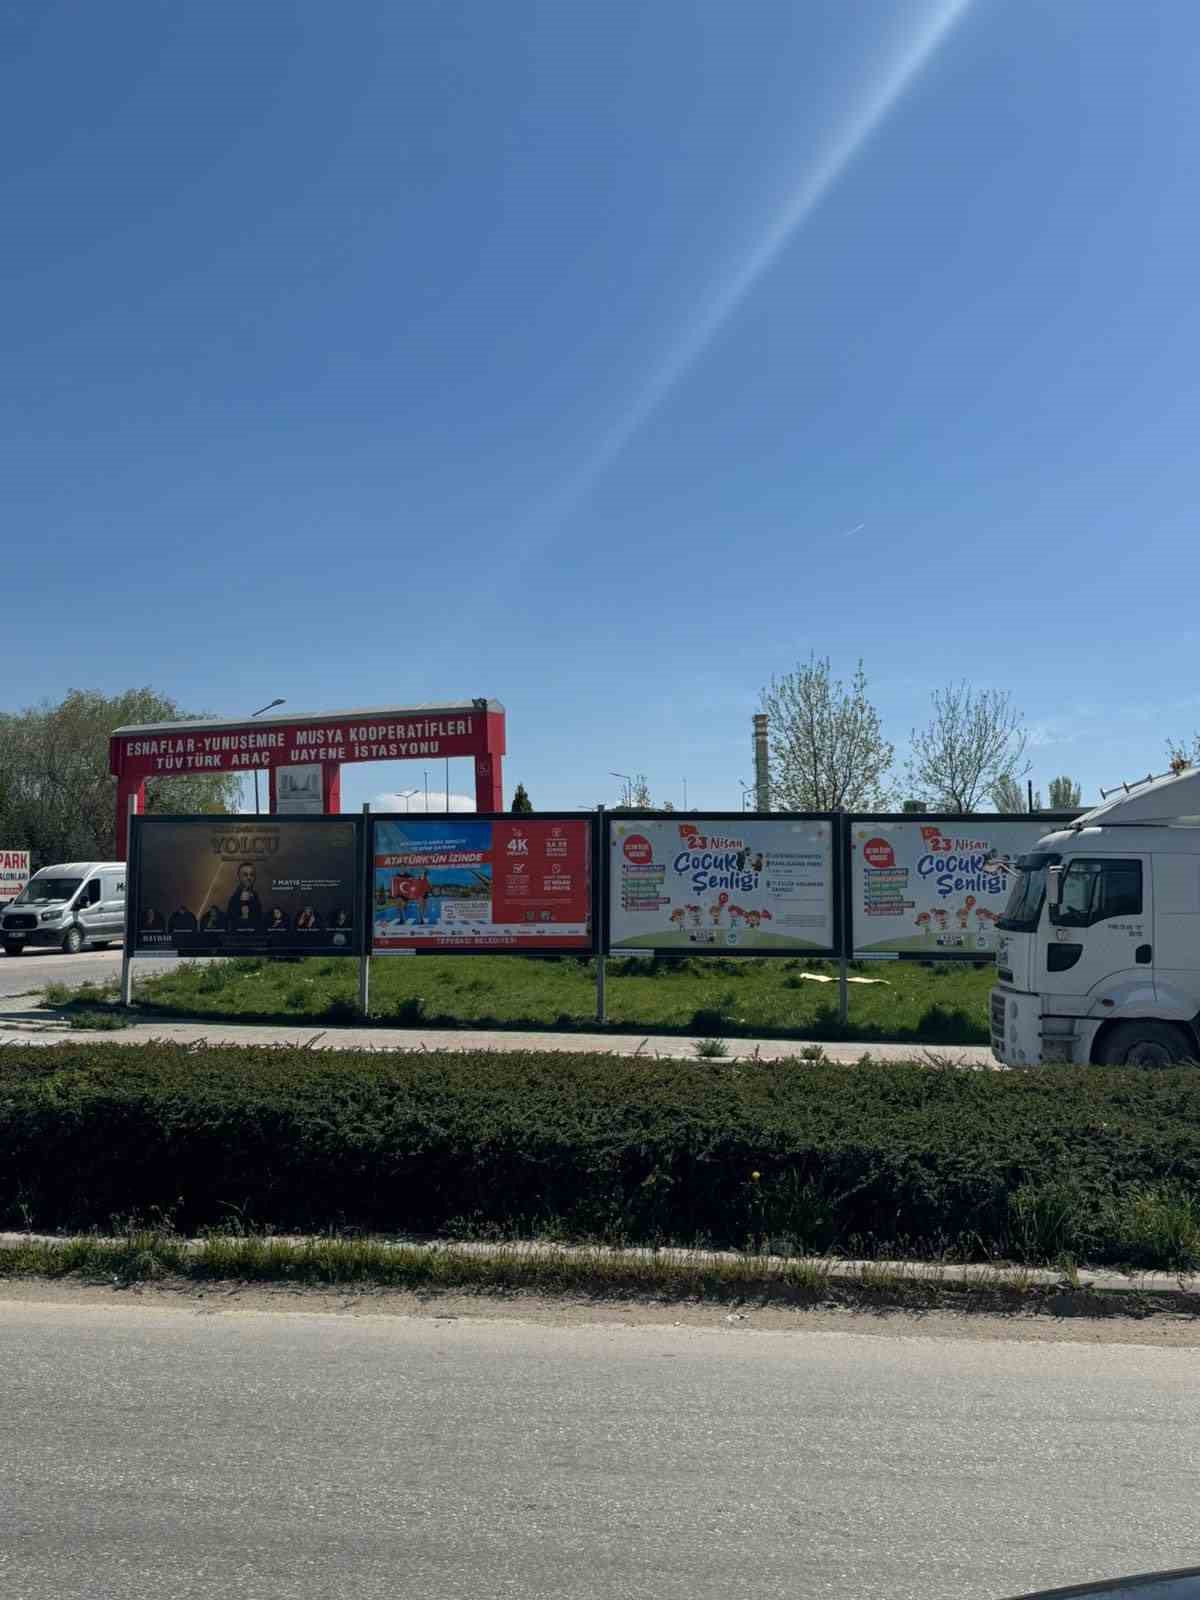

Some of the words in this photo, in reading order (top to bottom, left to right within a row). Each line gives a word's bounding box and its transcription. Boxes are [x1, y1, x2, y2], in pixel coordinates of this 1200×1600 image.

[296, 728, 343, 746] MUSYA
[349, 716, 473, 742] KOOPERATİFLERİ
[231, 751, 270, 766] ARAÇ
[354, 741, 440, 758] İSTASYONU
[507, 839, 529, 851] 4K
[688, 836, 707, 850] 23
[710, 837, 743, 849] Nisan
[930, 838, 952, 852] 23
[955, 839, 989, 851] Nisan
[692, 871, 759, 896] Şenliği
[936, 872, 1007, 899] Şenliği
